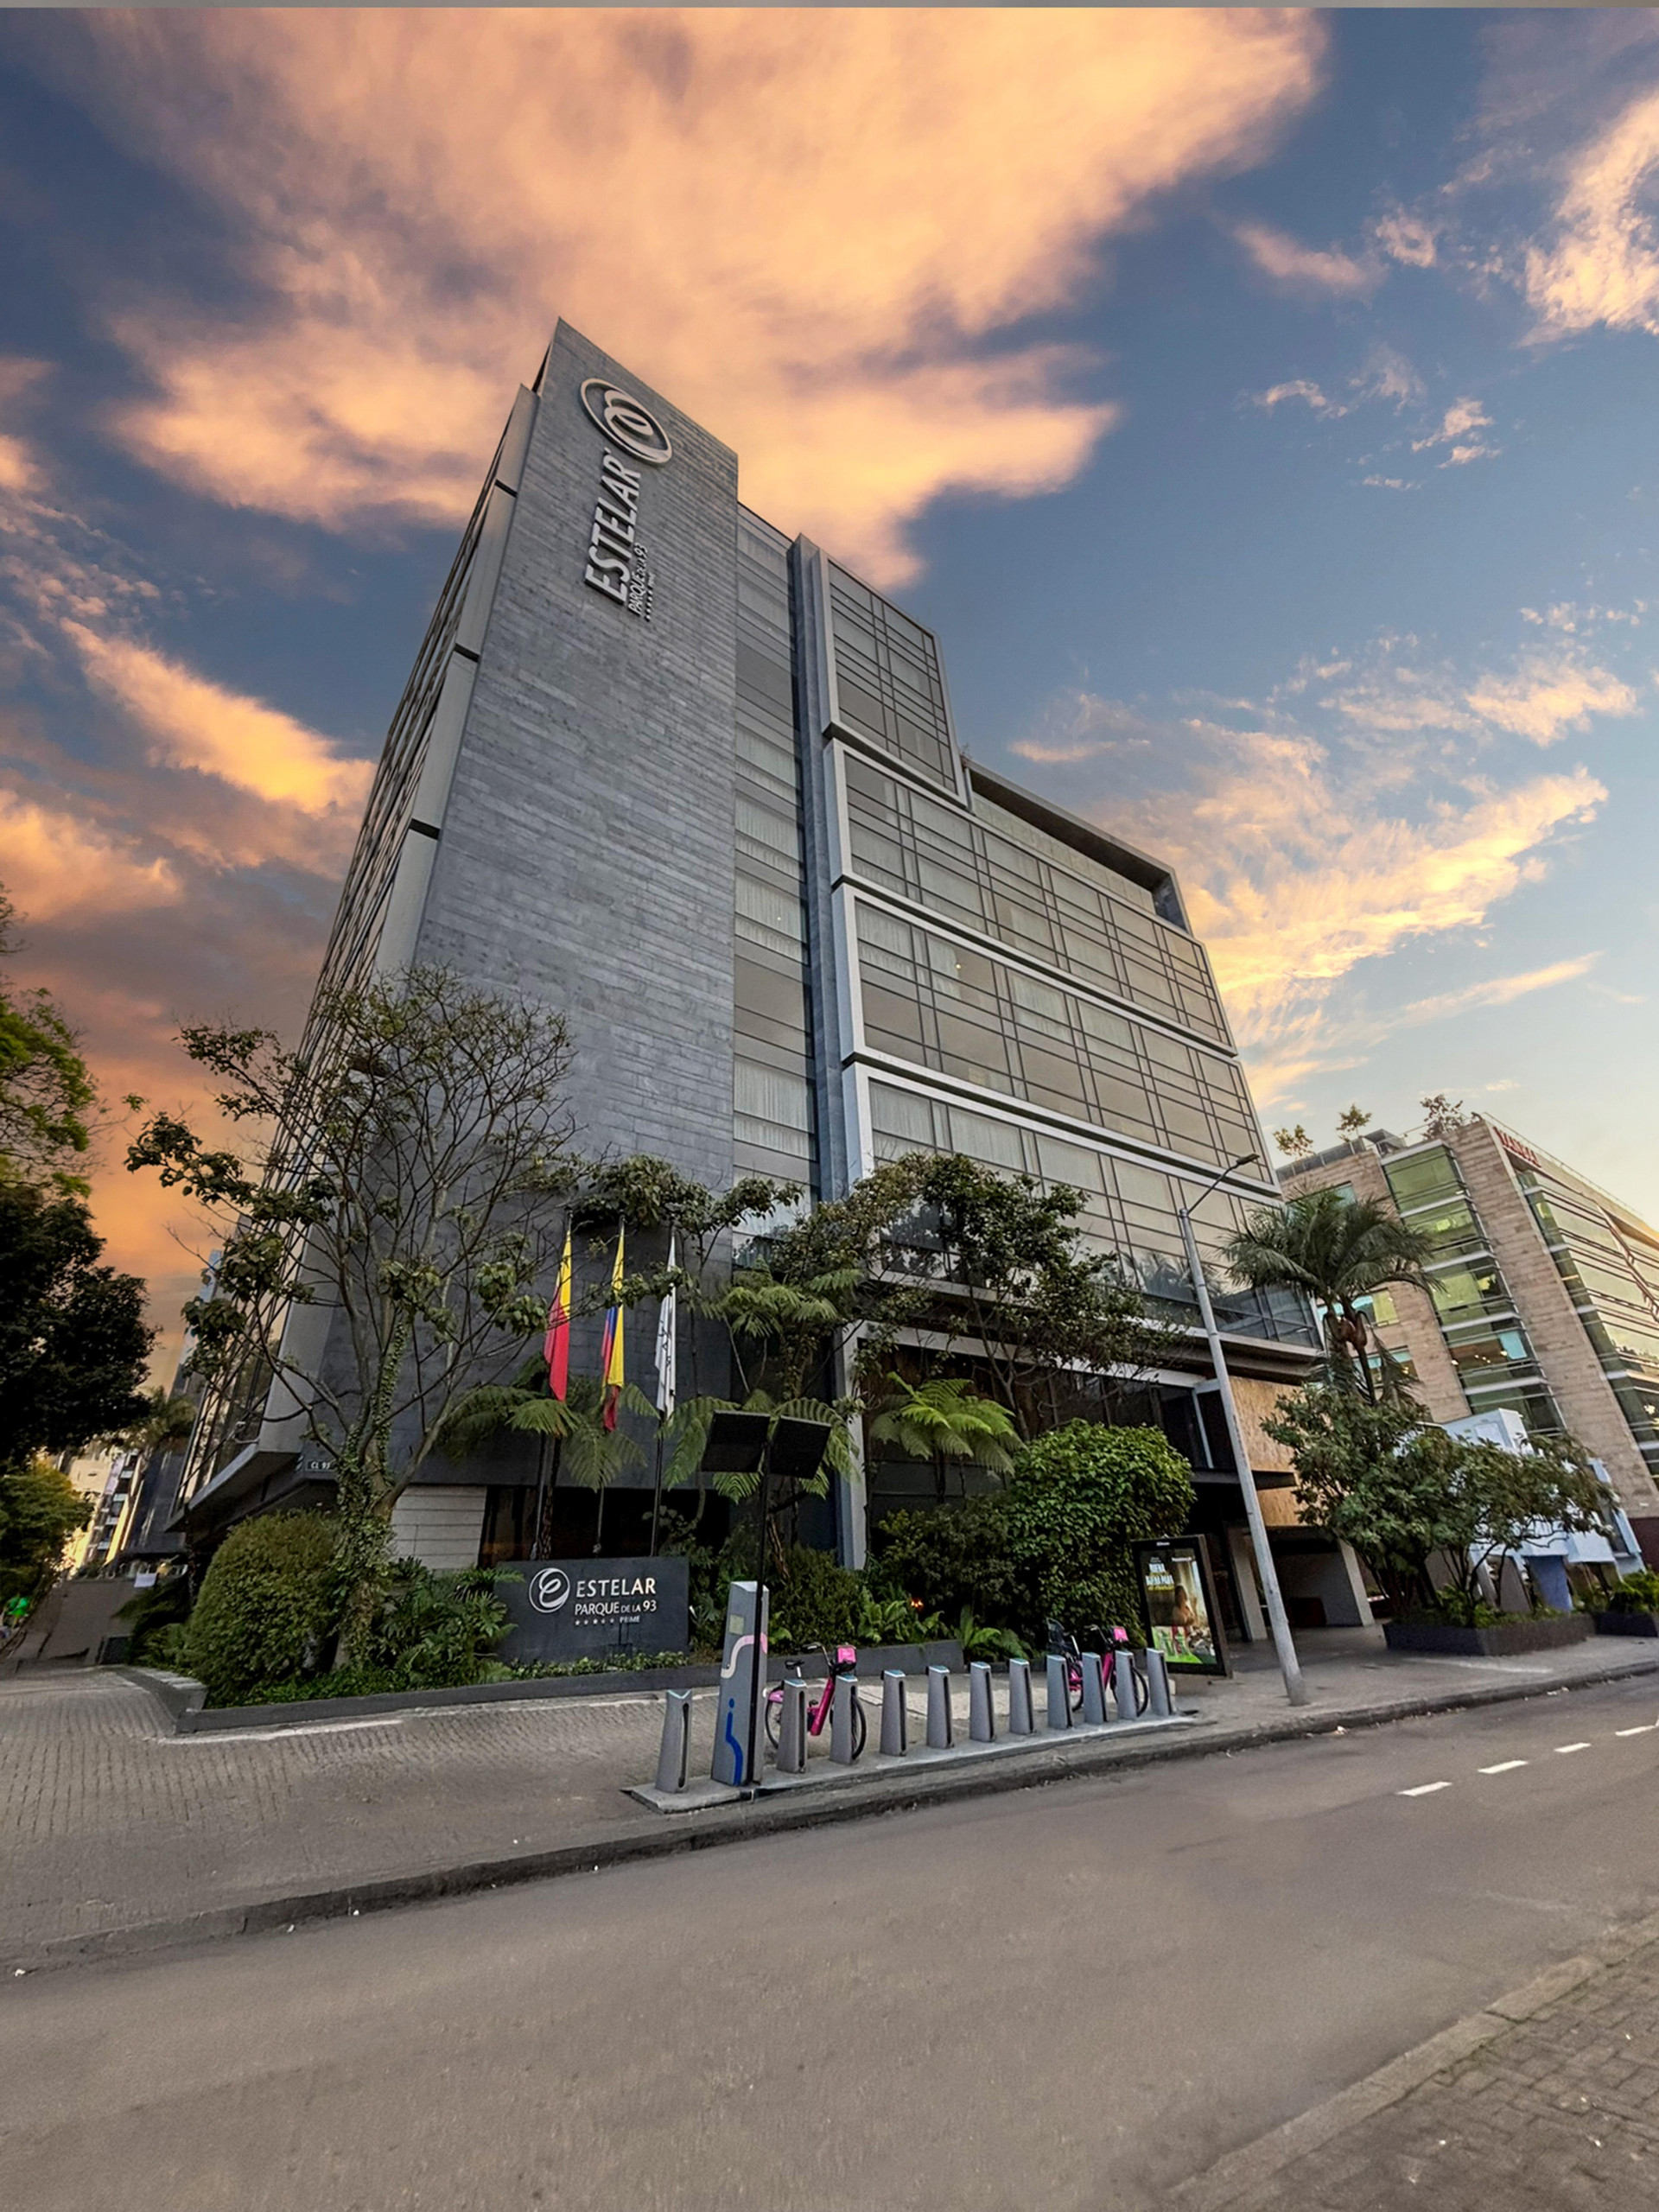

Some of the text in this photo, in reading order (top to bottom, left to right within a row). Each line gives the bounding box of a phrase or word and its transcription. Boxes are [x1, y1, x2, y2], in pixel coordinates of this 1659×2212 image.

[585, 454, 641, 602] ESTELAR
[634, 543, 648, 559] 93
[628, 571, 646, 615] PARQUE
[576, 1577, 656, 1598] ESTELAR
[575, 1602, 620, 1617] PARQUE
[620, 1605, 631, 1613] DE
[642, 1599, 657, 1612] 93
